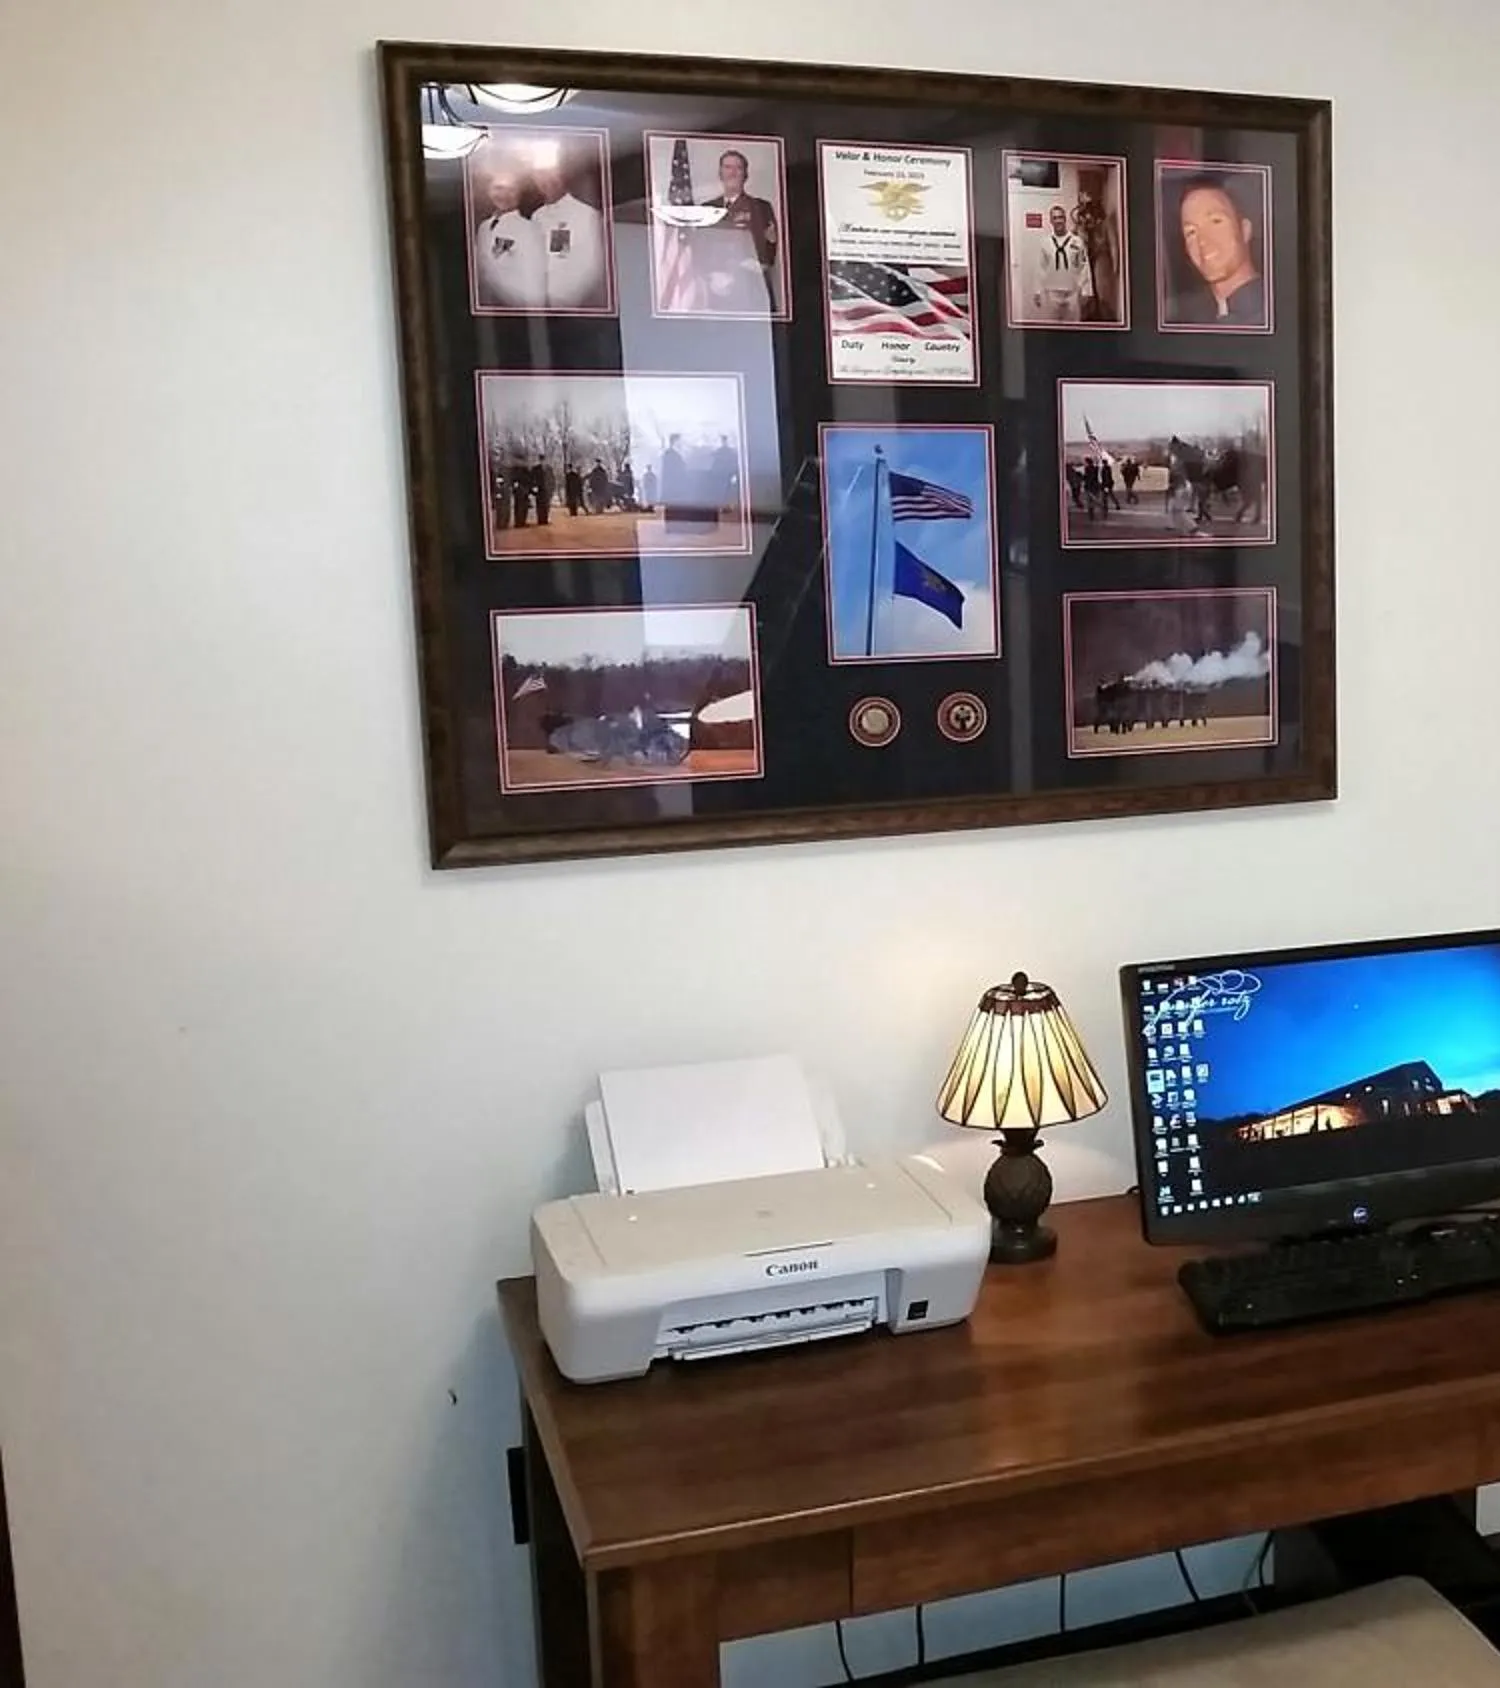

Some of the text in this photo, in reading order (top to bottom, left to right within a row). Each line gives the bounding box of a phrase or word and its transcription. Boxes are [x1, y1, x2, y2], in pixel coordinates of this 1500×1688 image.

[835, 151, 951, 167] Valor & Honor Ceremony
[841, 340, 960, 352] Duty Honor Country
[766, 1259, 818, 1276] Canon
